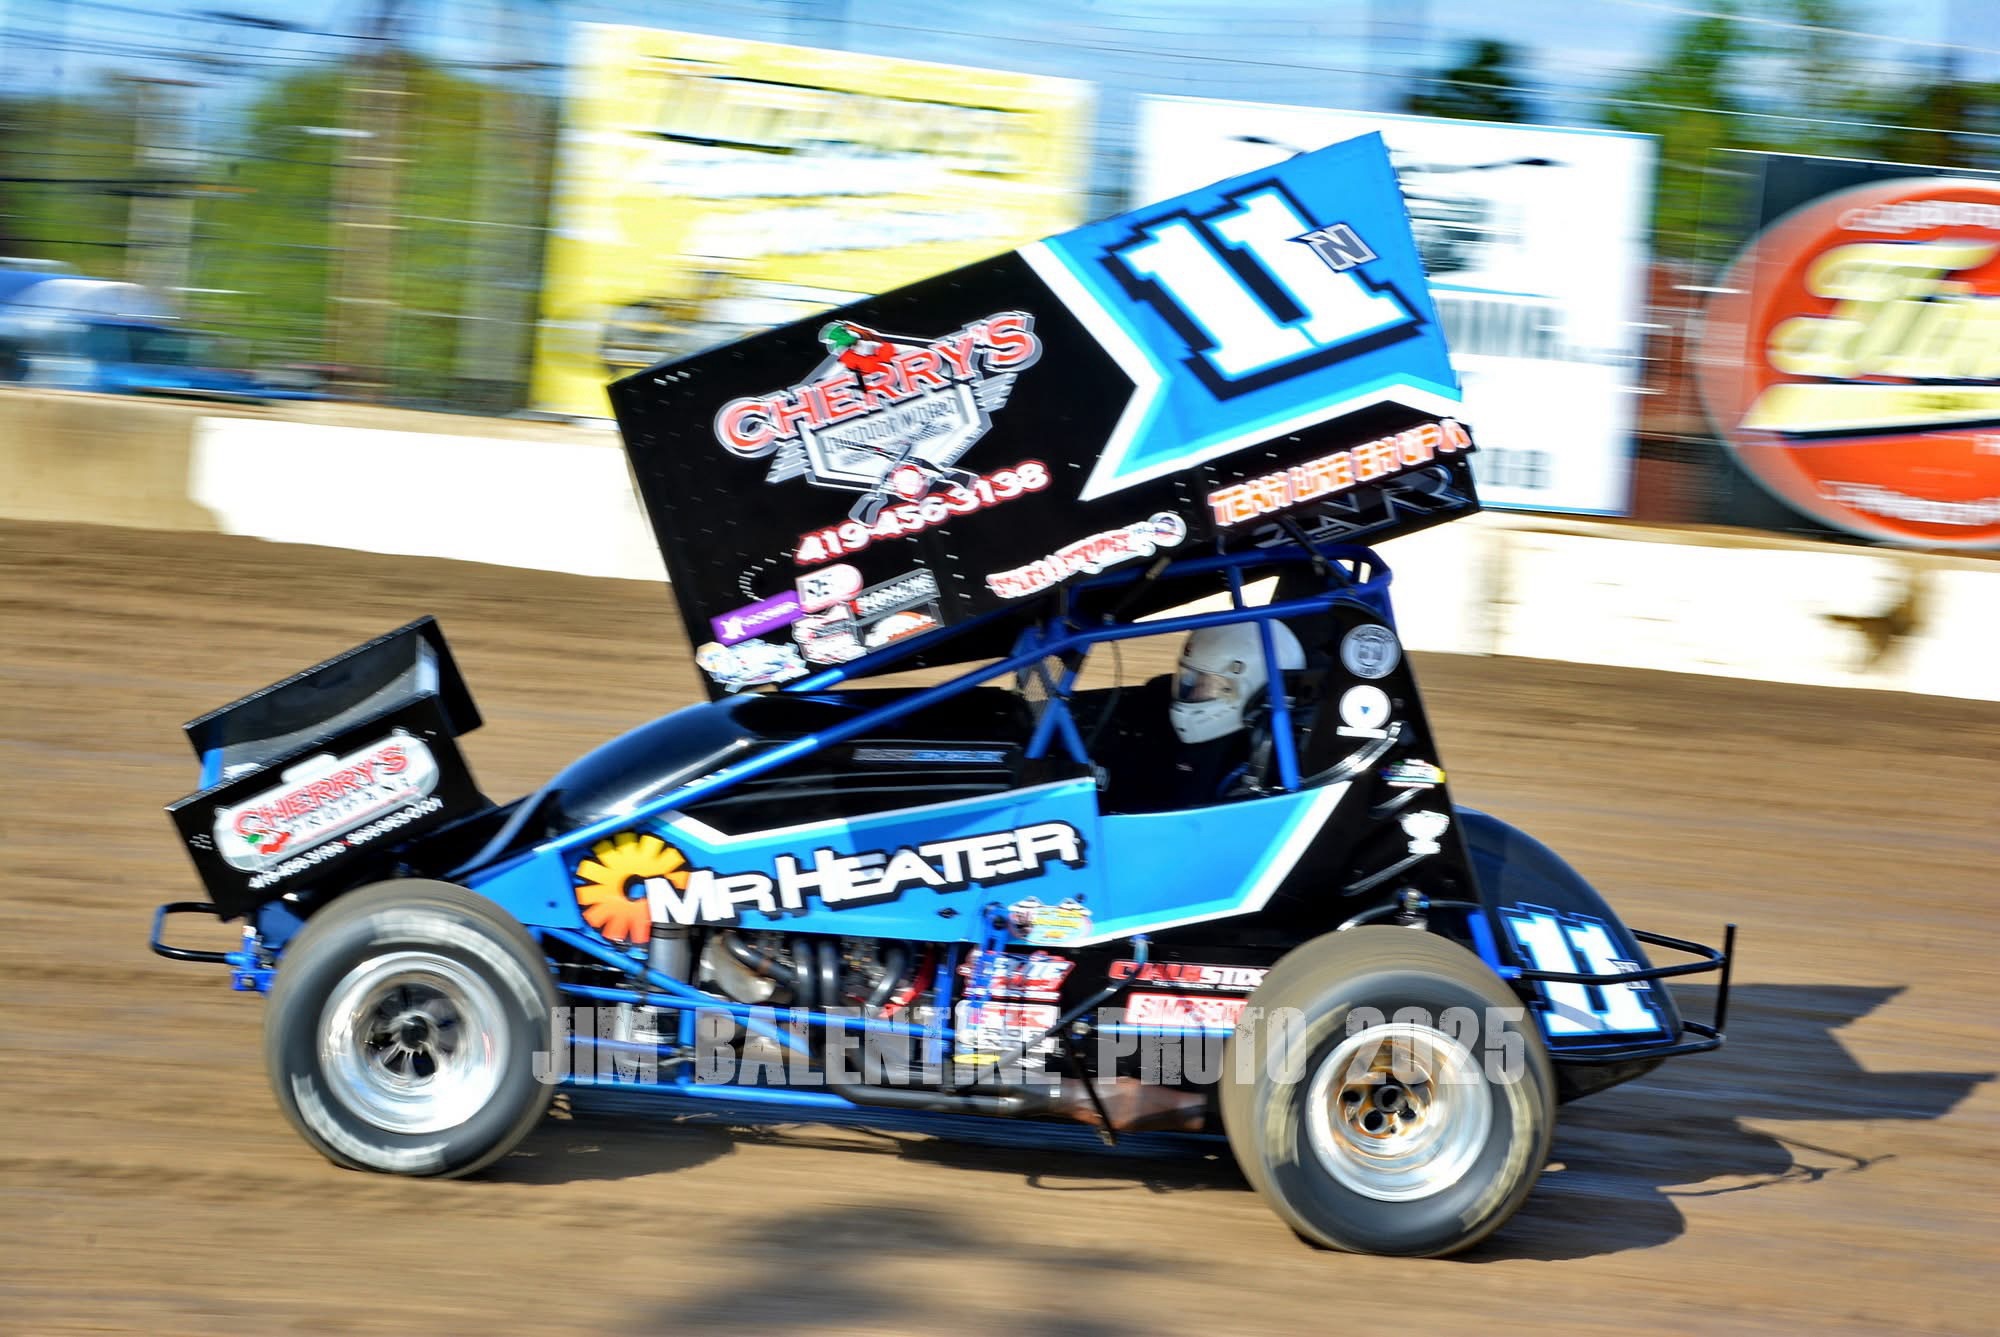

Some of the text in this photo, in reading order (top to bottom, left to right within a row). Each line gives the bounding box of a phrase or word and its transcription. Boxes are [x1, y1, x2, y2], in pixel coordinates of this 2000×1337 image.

[1110, 180, 1425, 392] 11
[716, 311, 1040, 456] CHERRY'S
[233, 744, 411, 837] CHERRY'S
[644, 822, 1086, 925] MR HEATER
[1503, 907, 1664, 1040] 11
